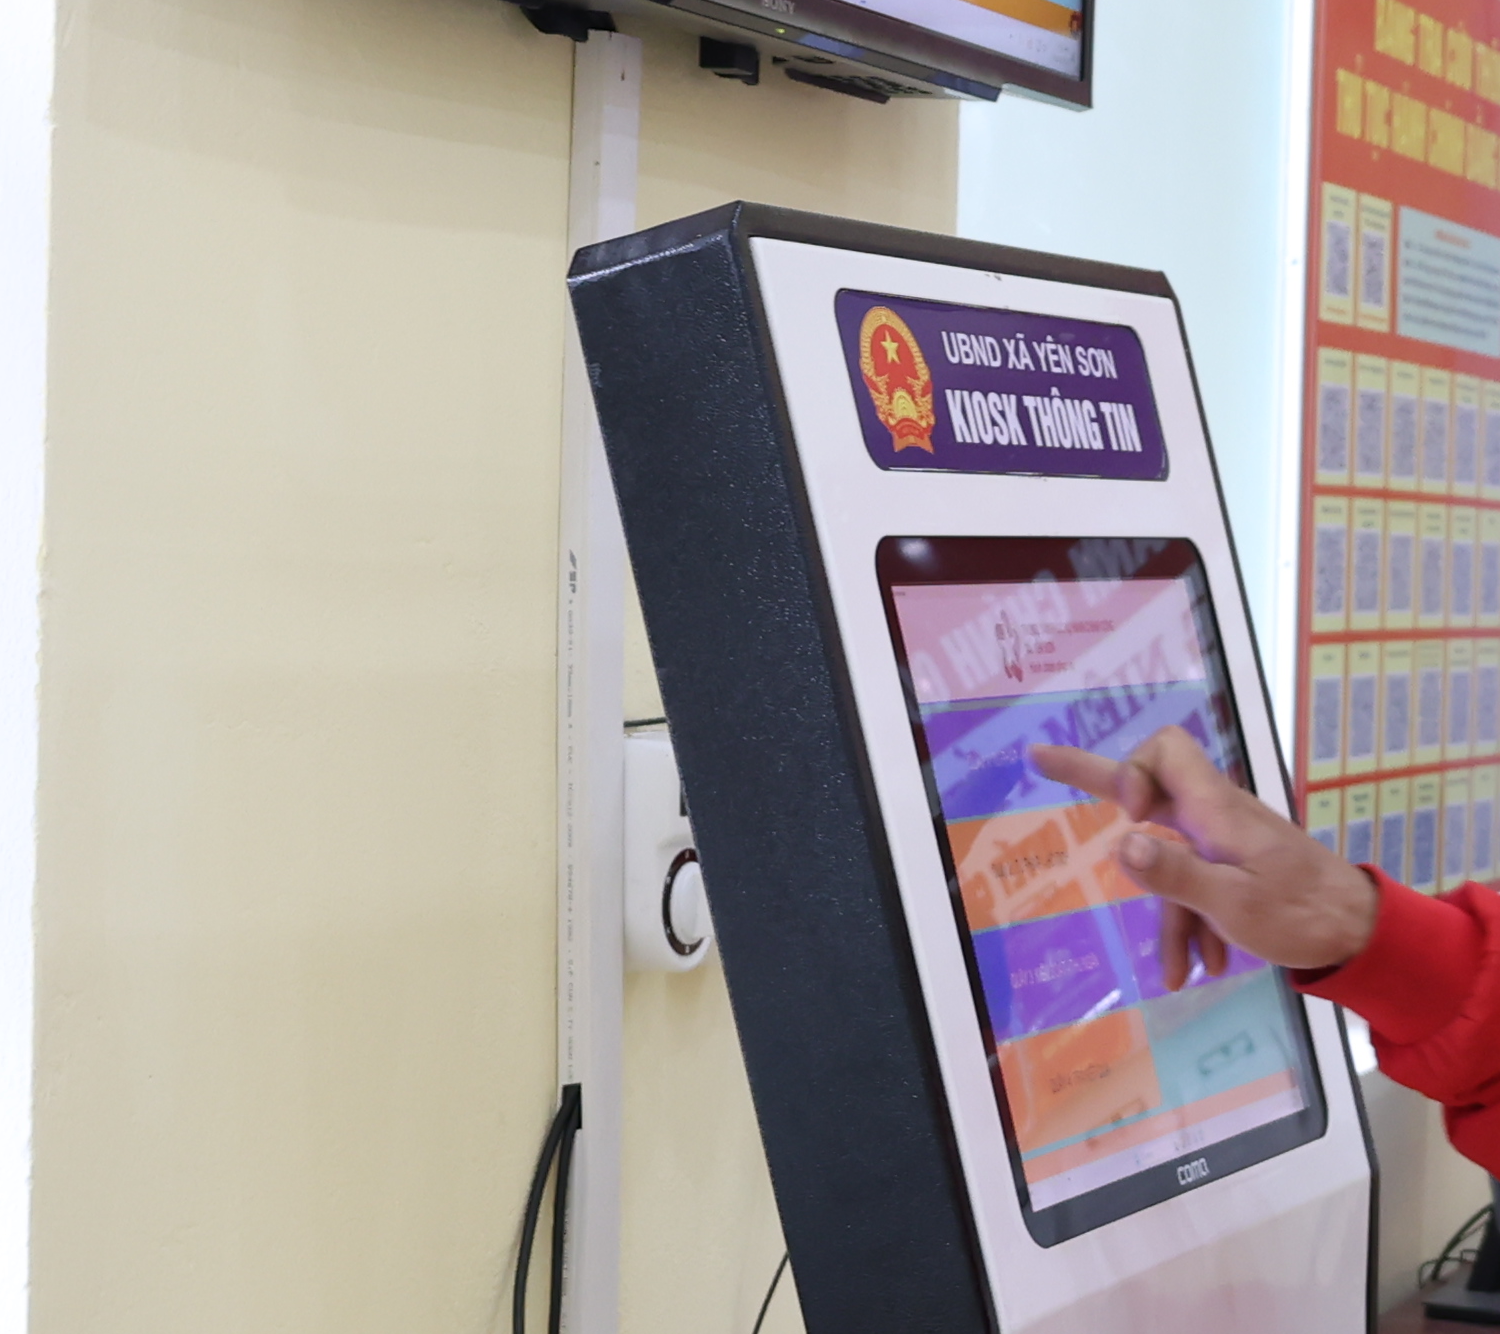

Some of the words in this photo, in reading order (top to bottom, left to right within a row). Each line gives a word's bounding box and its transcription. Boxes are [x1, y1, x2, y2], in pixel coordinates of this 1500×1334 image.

[941, 331, 1001, 368] UBND
[1002, 333, 1034, 371] XÃ
[1032, 335, 1075, 374] YÊN
[1075, 346, 1117, 379] SƠN
[945, 389, 1027, 446] KIOSK
[1022, 387, 1104, 450] THÔNG
[1099, 401, 1142, 452] TIN
